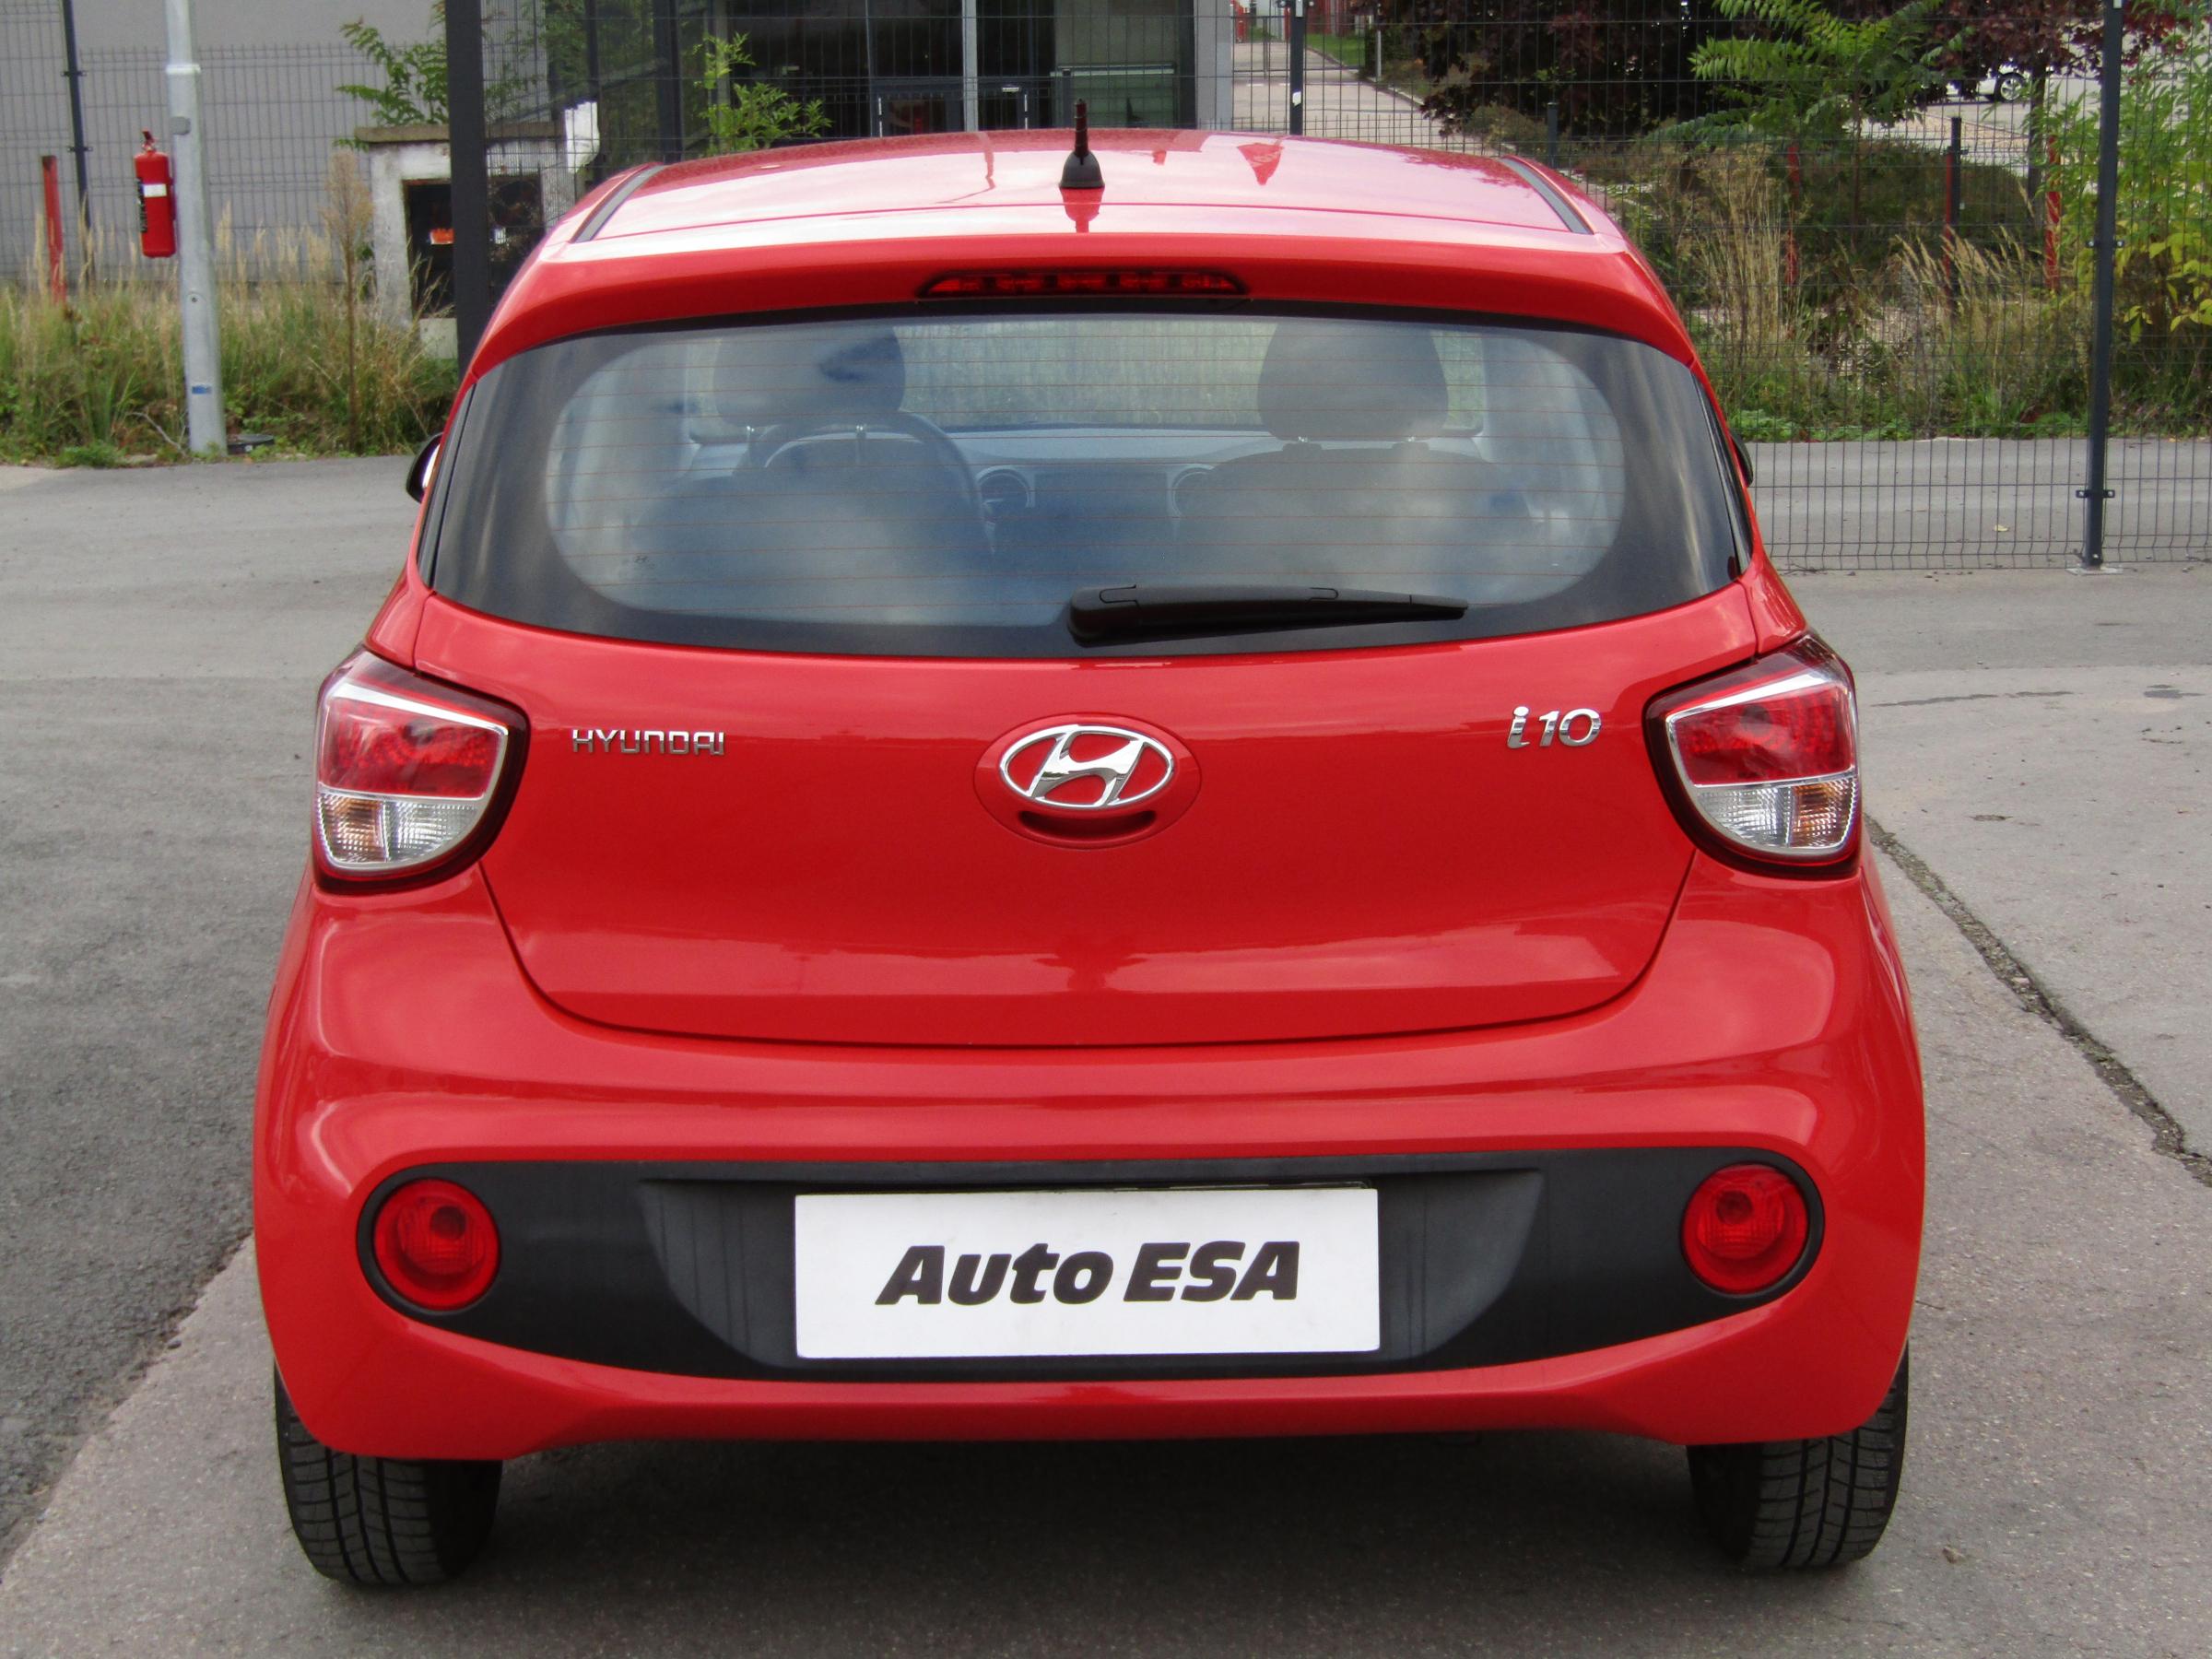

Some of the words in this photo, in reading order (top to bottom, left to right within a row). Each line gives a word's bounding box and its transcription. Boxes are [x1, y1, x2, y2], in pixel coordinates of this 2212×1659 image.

[571, 728, 724, 756] HYUNDAI
[1506, 705, 1602, 749] i10
[875, 1242, 1114, 1306] Auto
[1123, 1240, 1300, 1302] ESA
